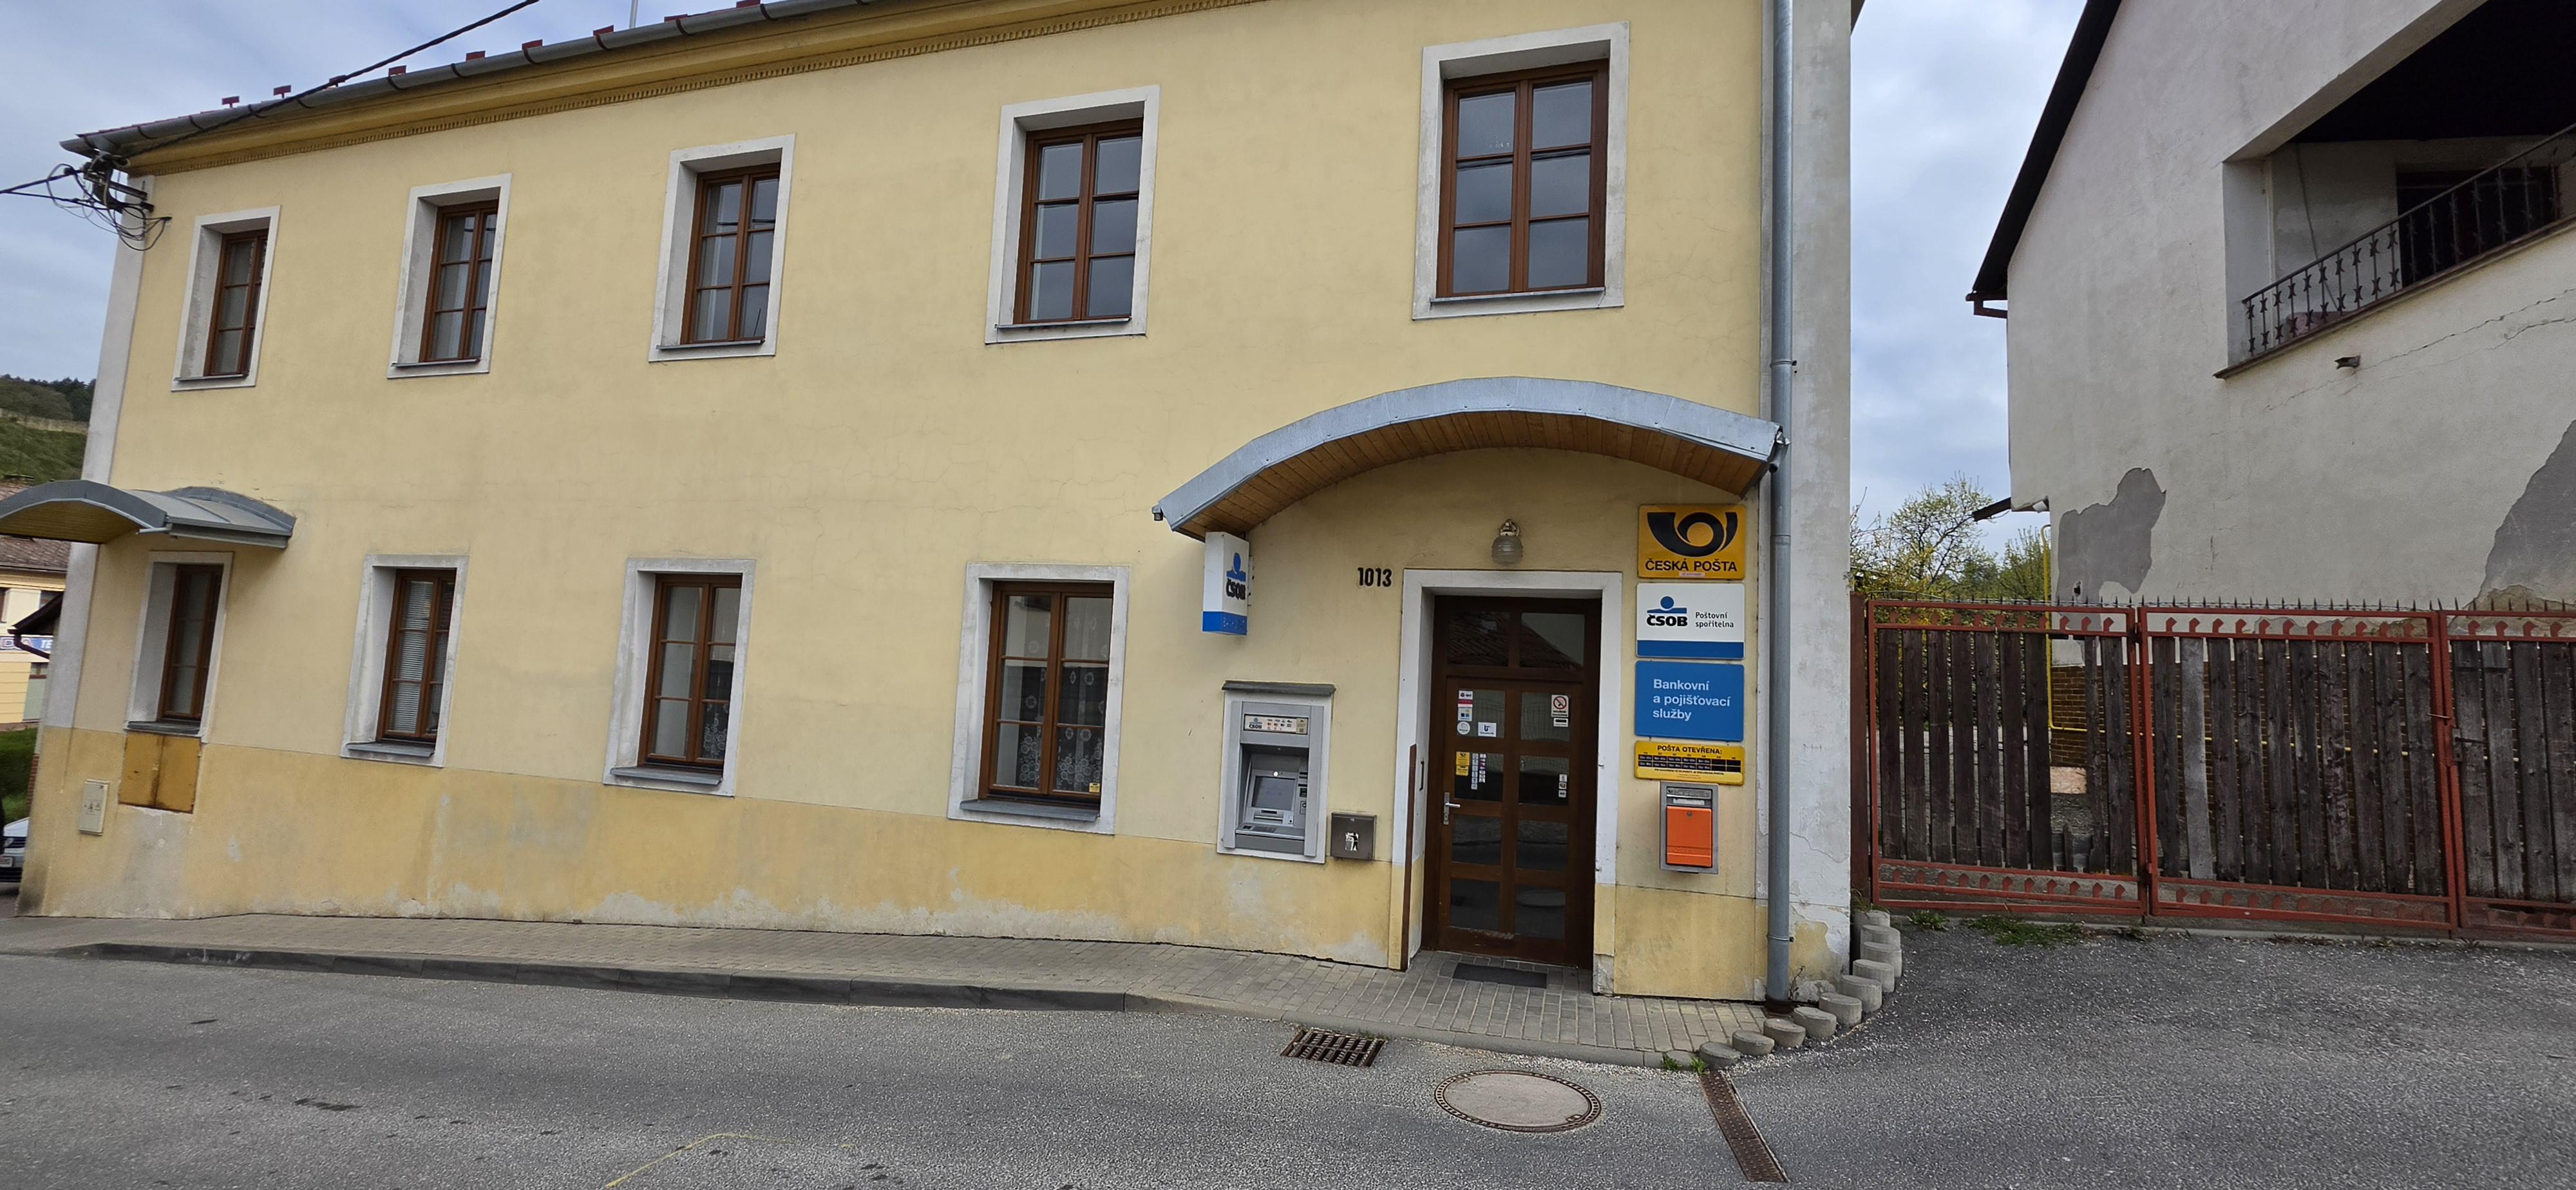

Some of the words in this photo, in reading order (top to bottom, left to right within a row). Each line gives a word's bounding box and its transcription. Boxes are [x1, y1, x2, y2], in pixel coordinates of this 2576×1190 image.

[1645, 558, 1689, 571] ČESKÁ
[1693, 559, 1738, 572] POŠTA
[1357, 567, 1392, 587] 1013
[1226, 578, 1246, 600] ČSOB
[1646, 614, 1688, 627] ČSOB
[1695, 611, 1728, 619] Poštovní
[1695, 619, 1734, 628] spořitelna
[1653, 678, 1710, 691] Bankovní
[1653, 695, 1661, 704] a
[1663, 694, 1731, 707] pojišťovací
[1653, 708, 1692, 722] služby
[1682, 746, 1723, 755] OTEVŘENA:
